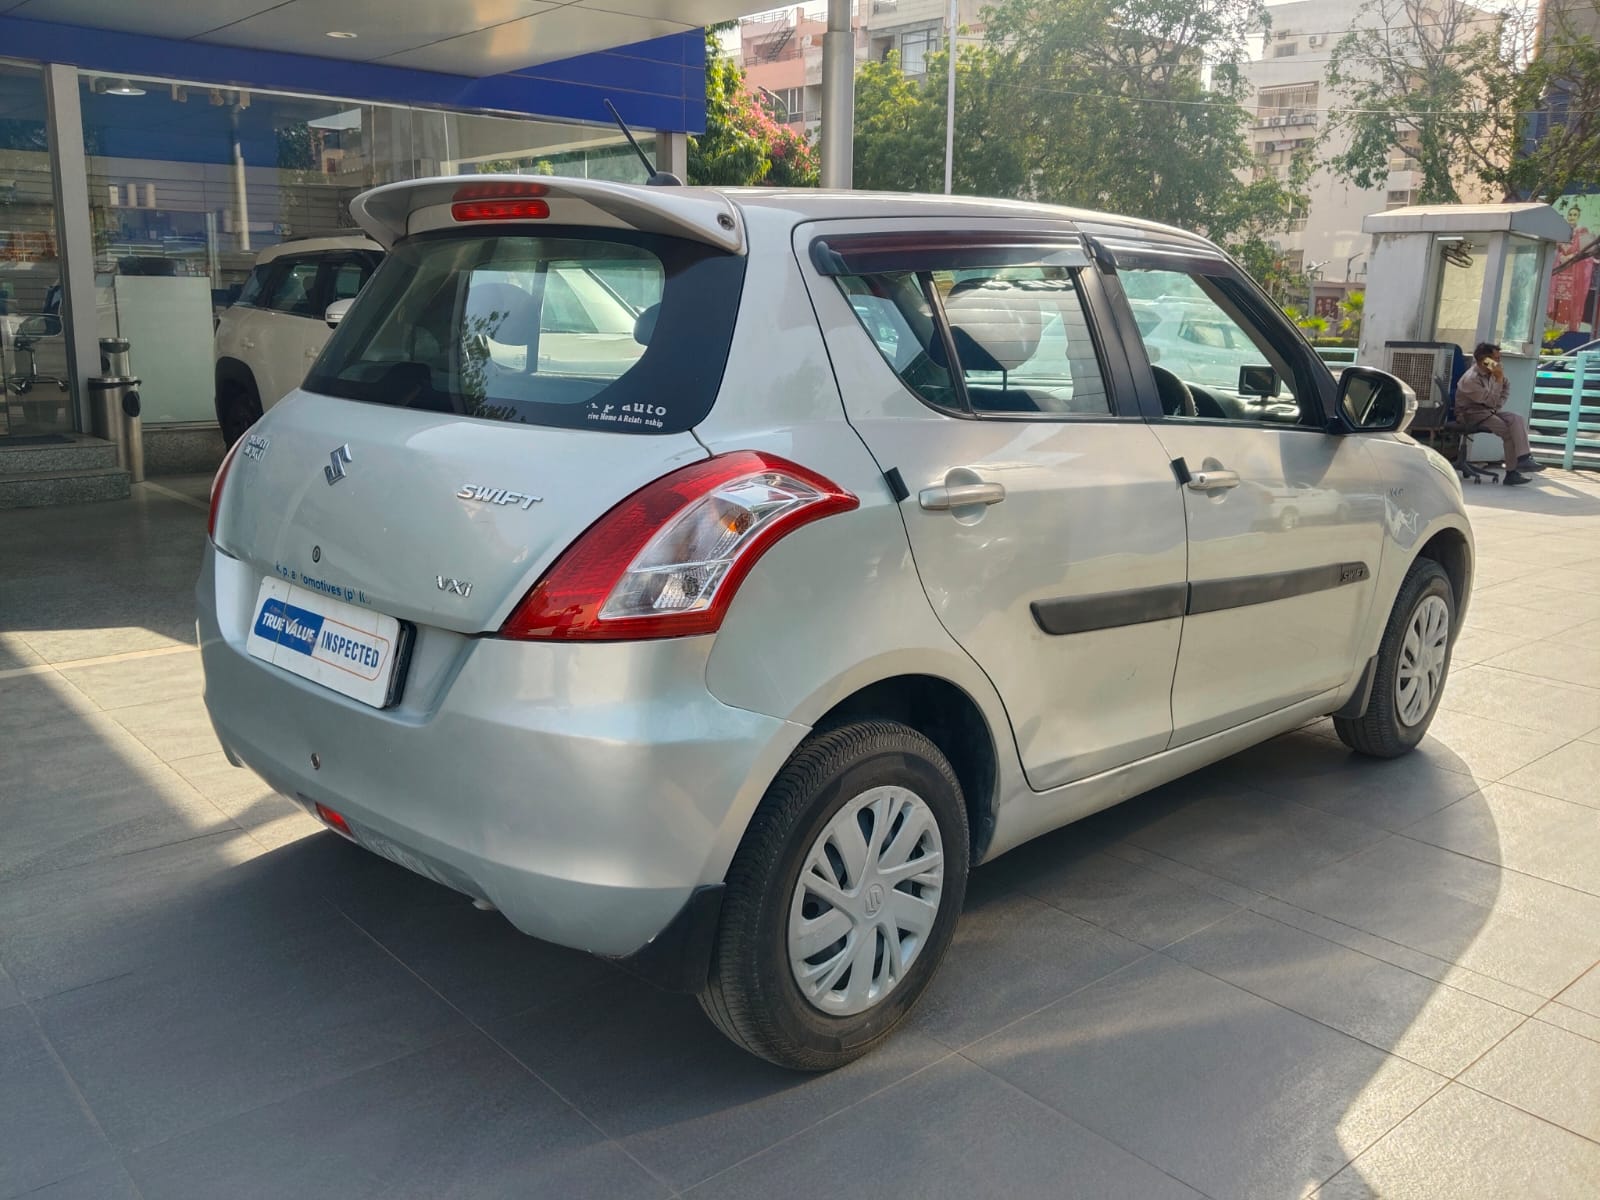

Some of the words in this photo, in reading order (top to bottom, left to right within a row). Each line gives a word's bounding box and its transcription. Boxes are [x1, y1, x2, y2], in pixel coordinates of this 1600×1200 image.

[623, 415, 664, 428] Relatinship
[457, 484, 544, 510] SWIFT
[262, 612, 286, 632] TRUE
[285, 618, 316, 642] VALUE
[321, 630, 380, 668] INSPECTED
